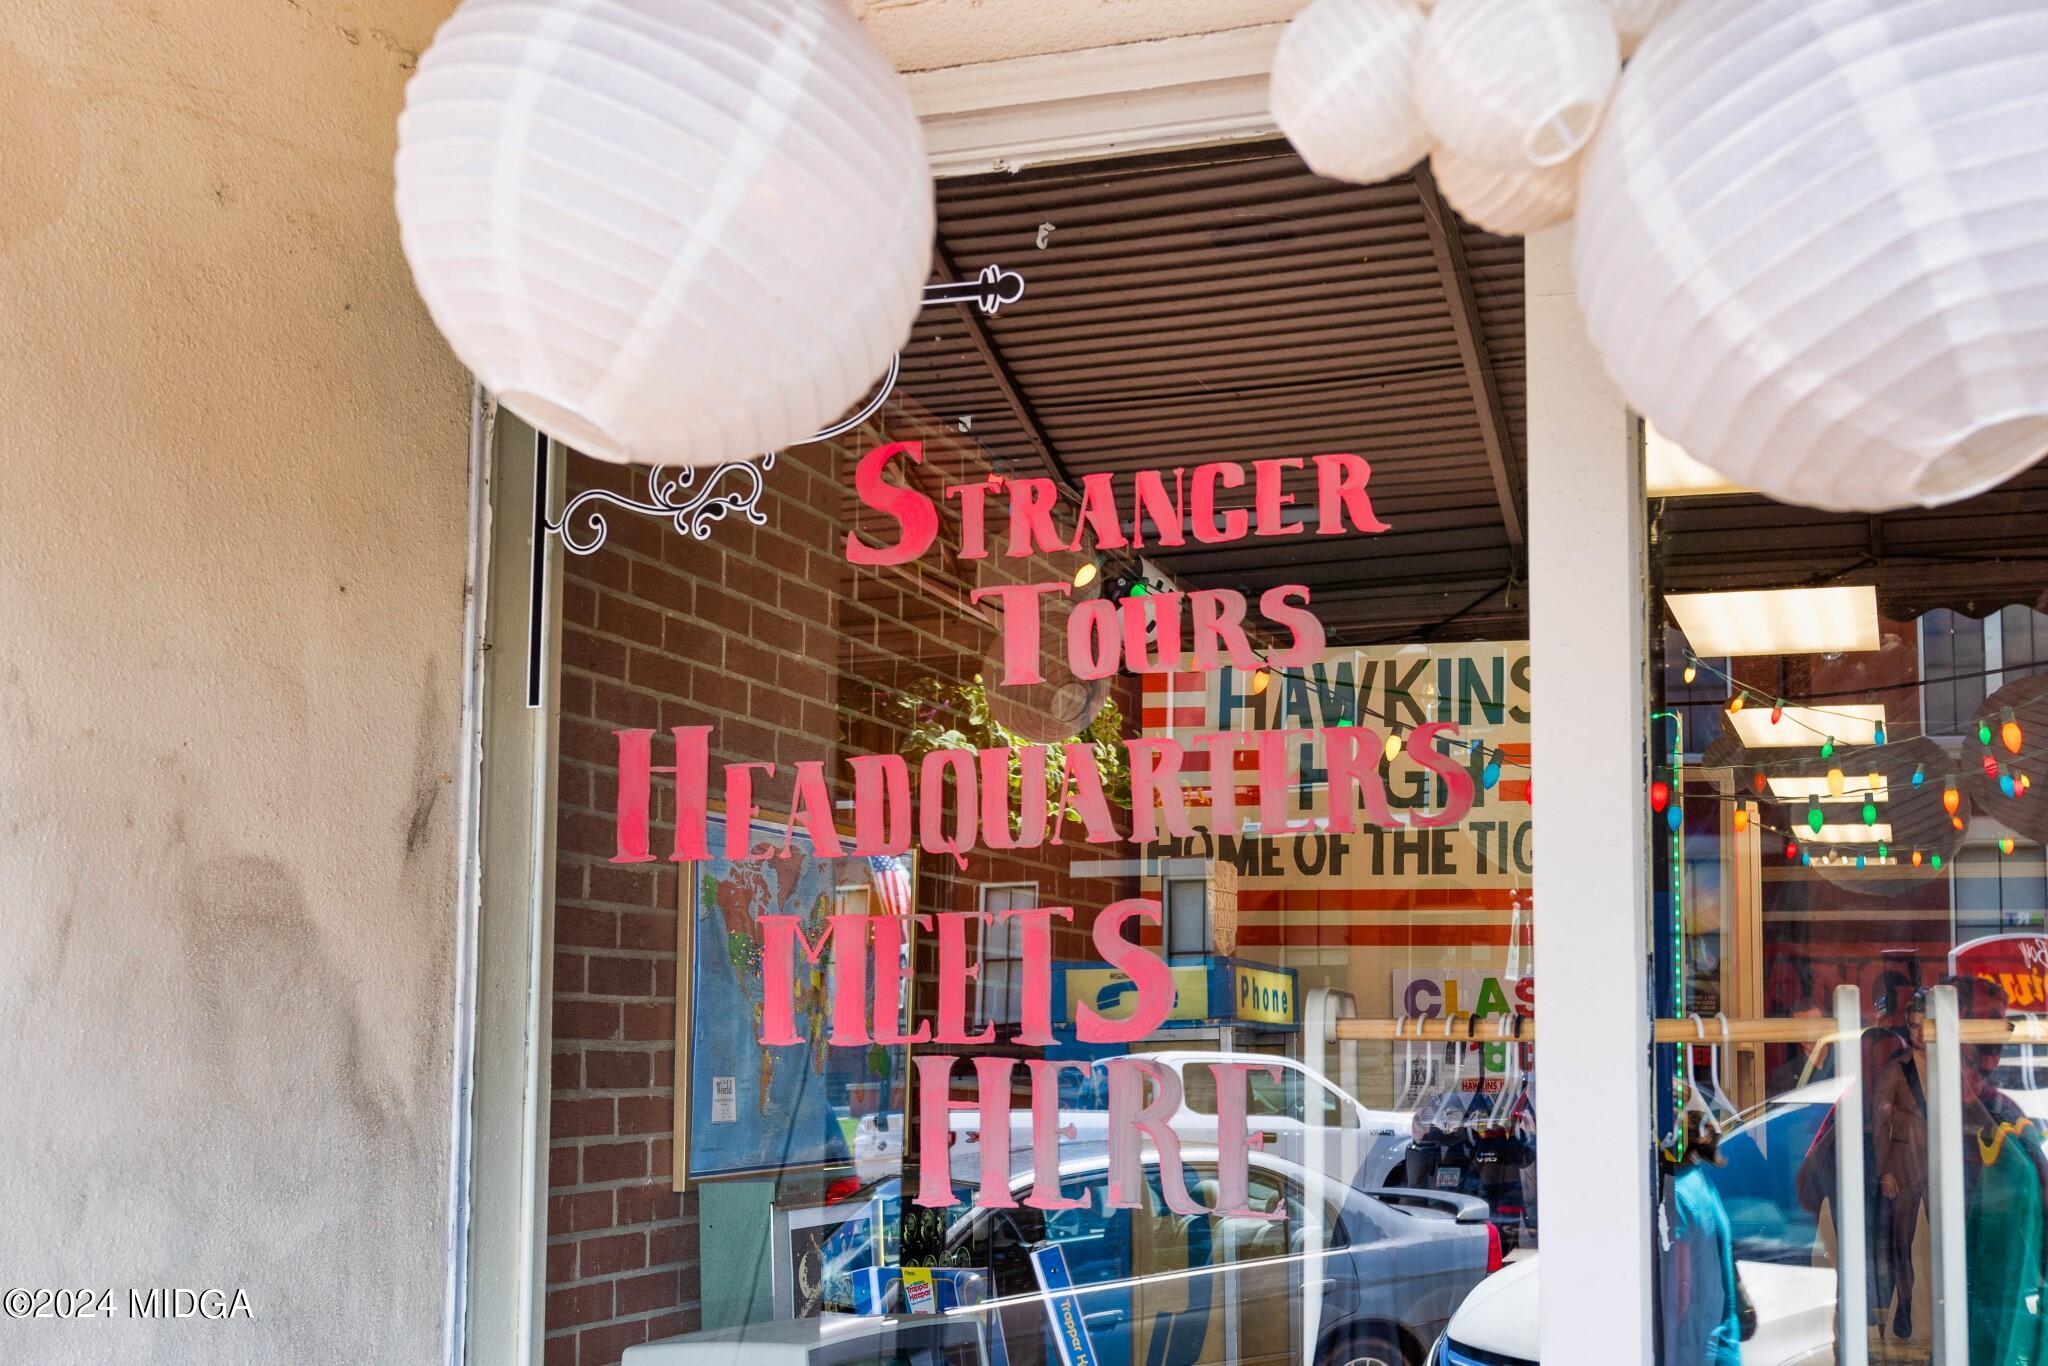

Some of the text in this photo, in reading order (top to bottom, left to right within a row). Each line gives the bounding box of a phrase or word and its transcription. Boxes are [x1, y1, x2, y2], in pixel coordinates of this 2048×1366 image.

[846, 441, 1393, 566] STRANGER
[970, 582, 1326, 686] TOURS
[1219, 655, 1531, 731] HAWKINS
[609, 722, 1475, 871] HEADQUARTERS
[1294, 825, 1349, 876] OF
[1364, 822, 1459, 875] THE
[757, 898, 1175, 1047] MEETS
[1241, 975, 1288, 1015] Phone
[912, 1055, 1289, 1221] HERE
[906, 1283, 929, 1293] Trapper
[1060, 1300, 1082, 1351] Trapper
